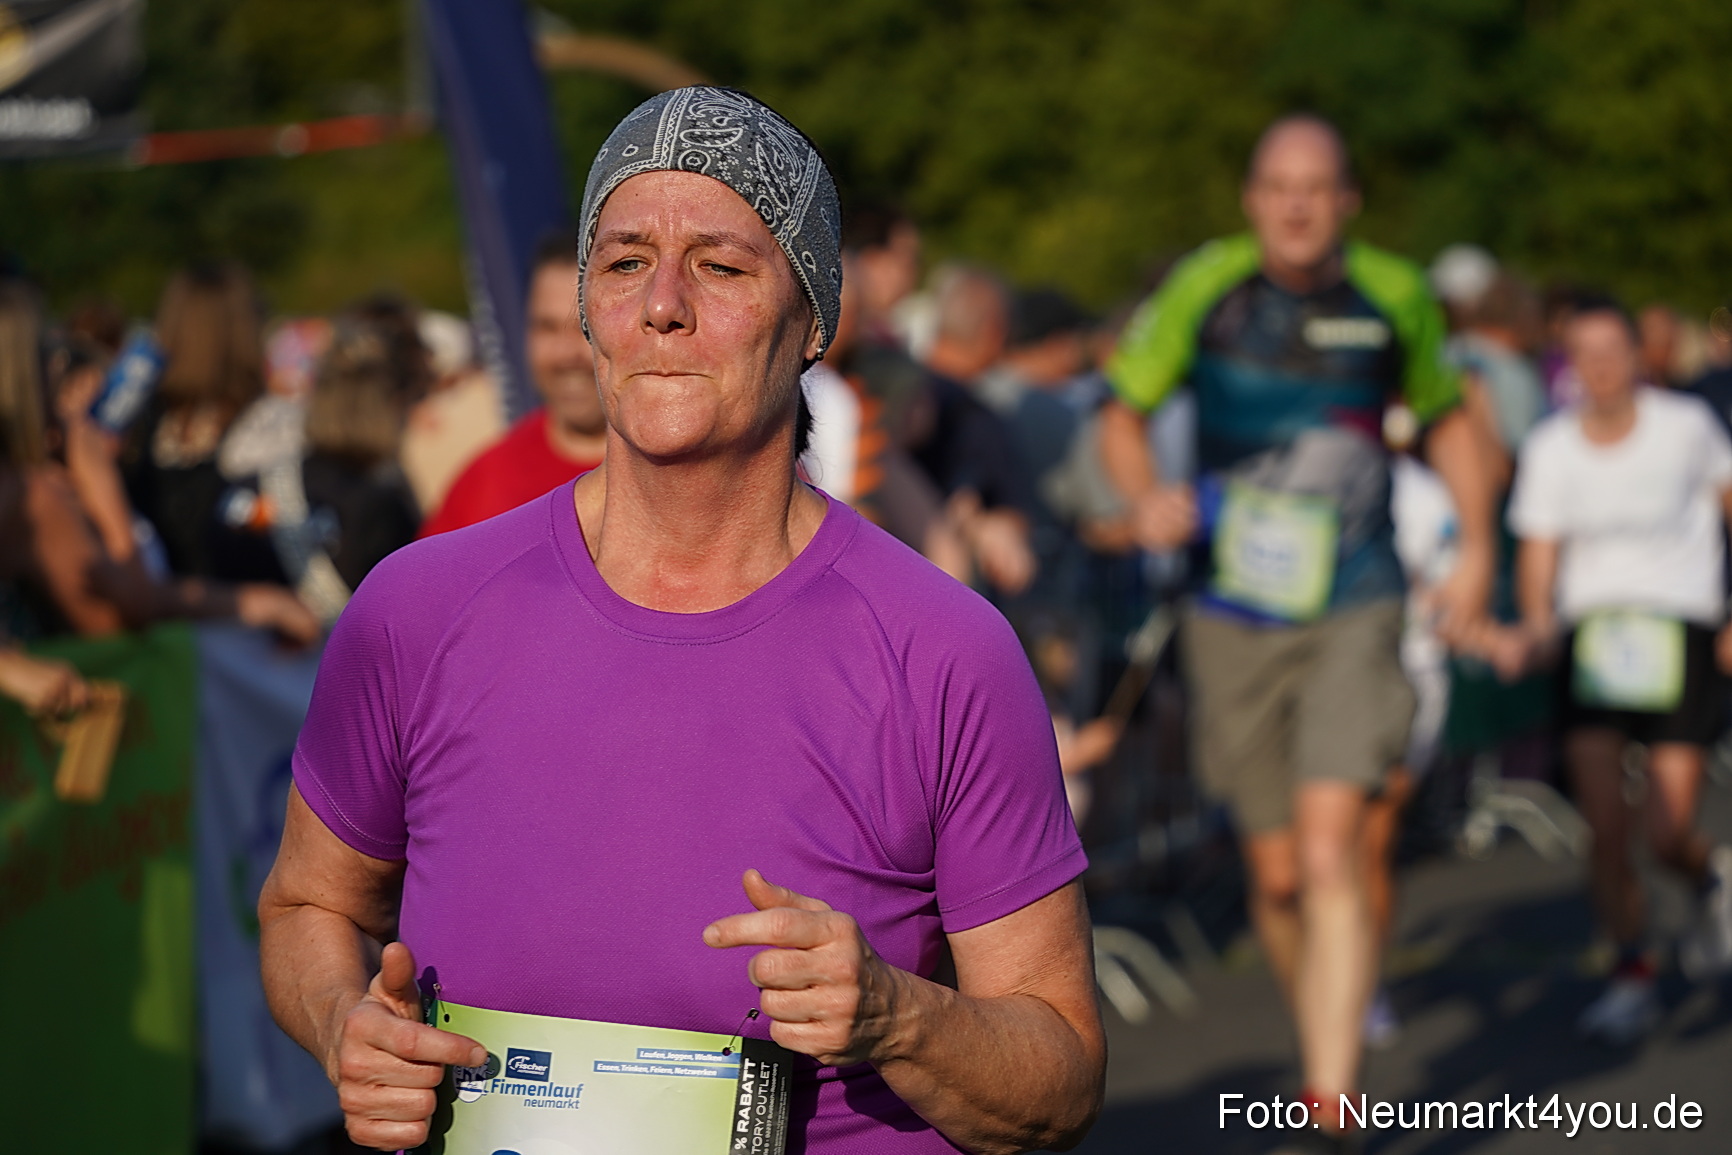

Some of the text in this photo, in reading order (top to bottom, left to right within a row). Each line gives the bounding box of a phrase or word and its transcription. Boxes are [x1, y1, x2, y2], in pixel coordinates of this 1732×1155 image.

[514, 1060, 549, 1072] Fischer
[674, 1067, 718, 1076] Netzwerken
[491, 1079, 584, 1098] Firmenlauf
[737, 1058, 756, 1132] RABATT
[755, 1061, 771, 1116] OUTLET
[523, 1098, 580, 1110] neumarkt
